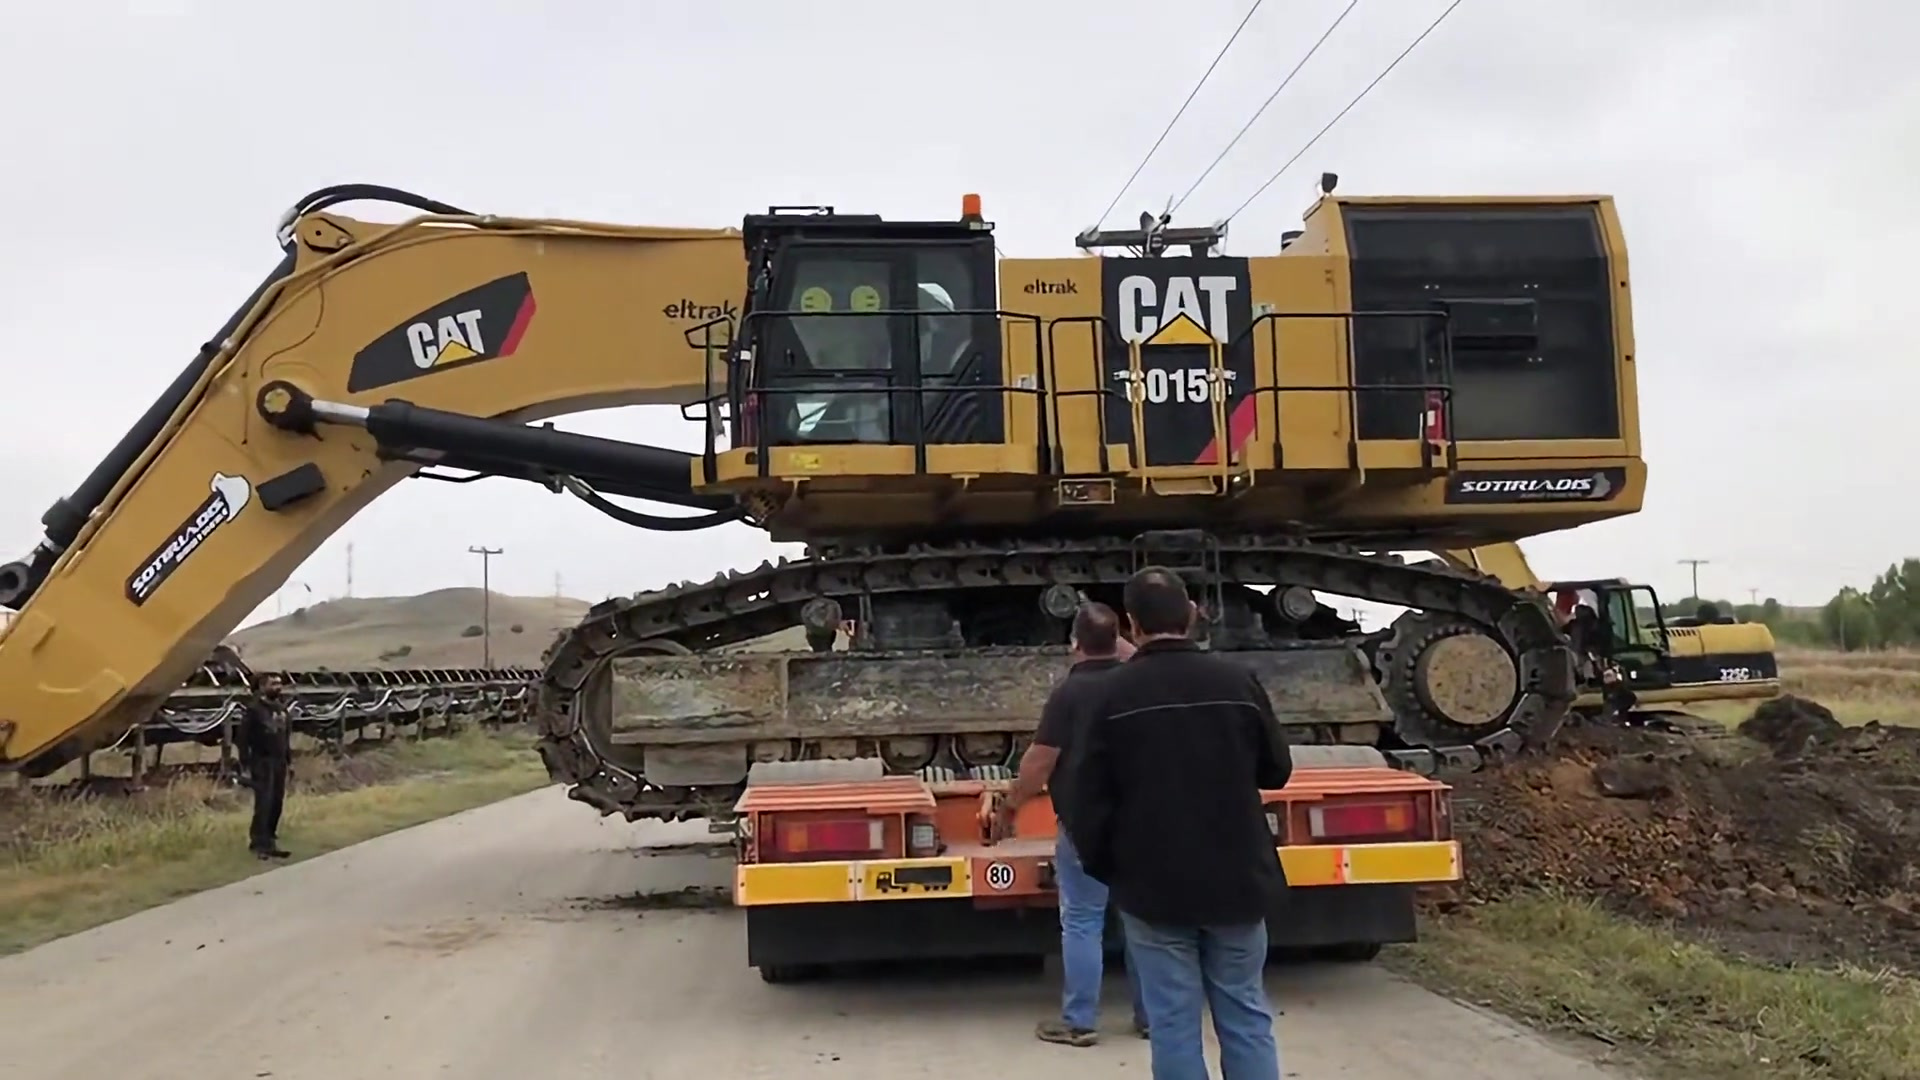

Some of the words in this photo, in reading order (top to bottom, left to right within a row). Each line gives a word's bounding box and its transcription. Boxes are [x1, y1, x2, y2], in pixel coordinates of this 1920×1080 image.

[1023, 278, 1078, 294] eltrak
[661, 298, 737, 321] eltrak
[1118, 275, 1237, 345] CAT
[406, 309, 485, 369] CAT
[1460, 478, 1593, 493] SOTIRIADIS
[990, 866, 1011, 884] 80
